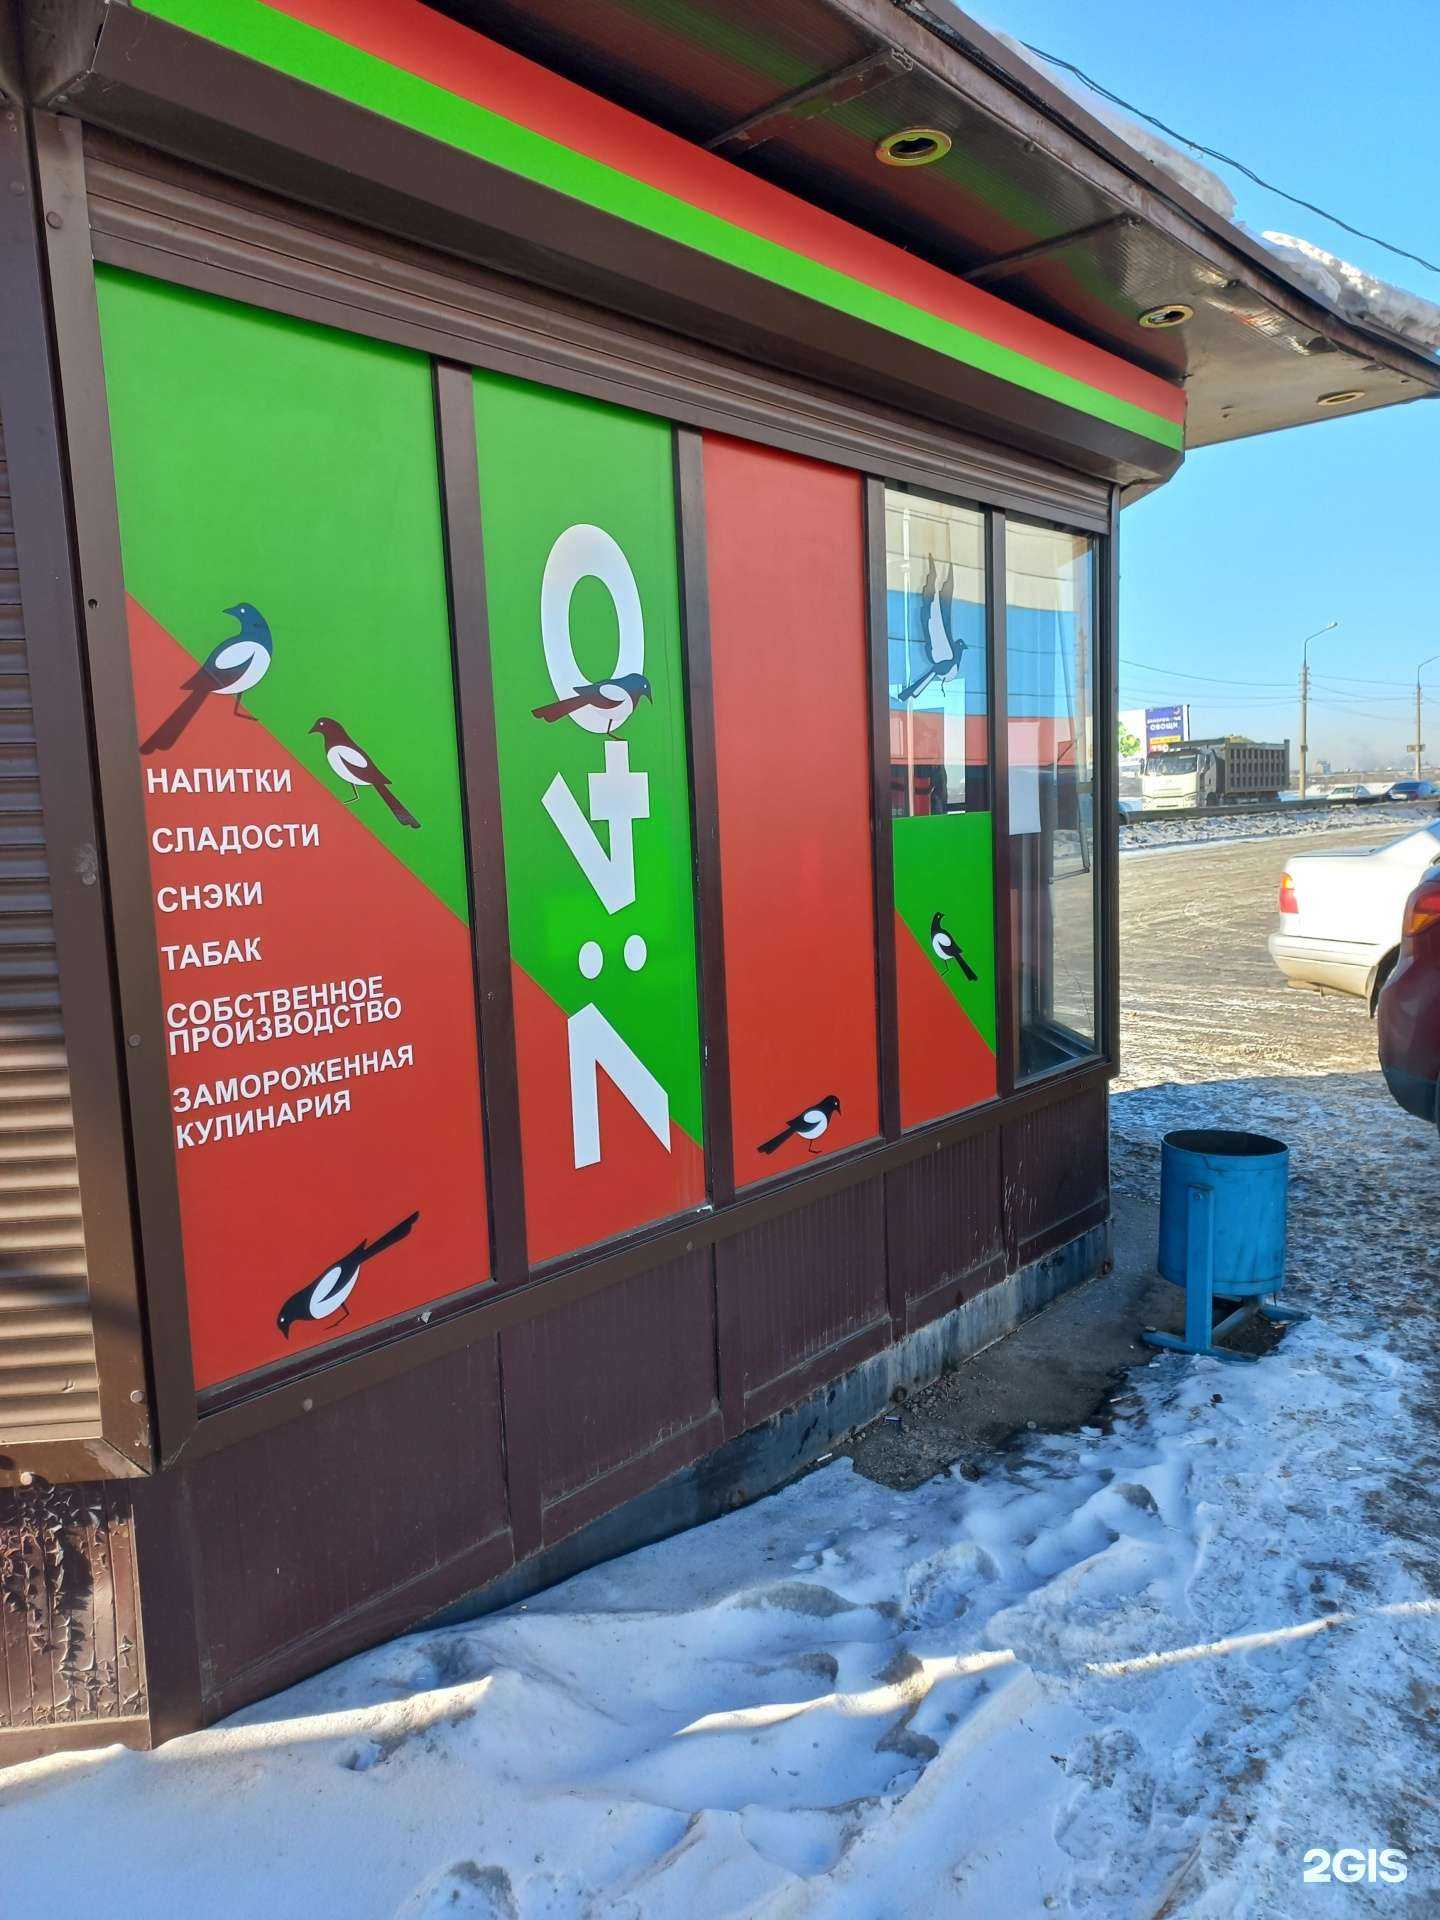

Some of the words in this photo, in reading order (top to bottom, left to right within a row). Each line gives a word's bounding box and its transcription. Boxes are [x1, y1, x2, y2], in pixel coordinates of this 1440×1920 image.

[146, 768, 292, 794] НАПИТКИ
[151, 823, 320, 855] СЛАДОСТИ
[156, 881, 263, 913] СНЭКИ
[161, 936, 262, 971] ТАБАК
[166, 975, 384, 1029] СОБСТВЕННОЕ
[169, 997, 402, 1056] ПРОИЗВОДСТВО
[172, 1044, 414, 1113] ЗАМОРОЖЕННАЯ
[175, 1089, 351, 1150] КУЛИНАРИЯ
